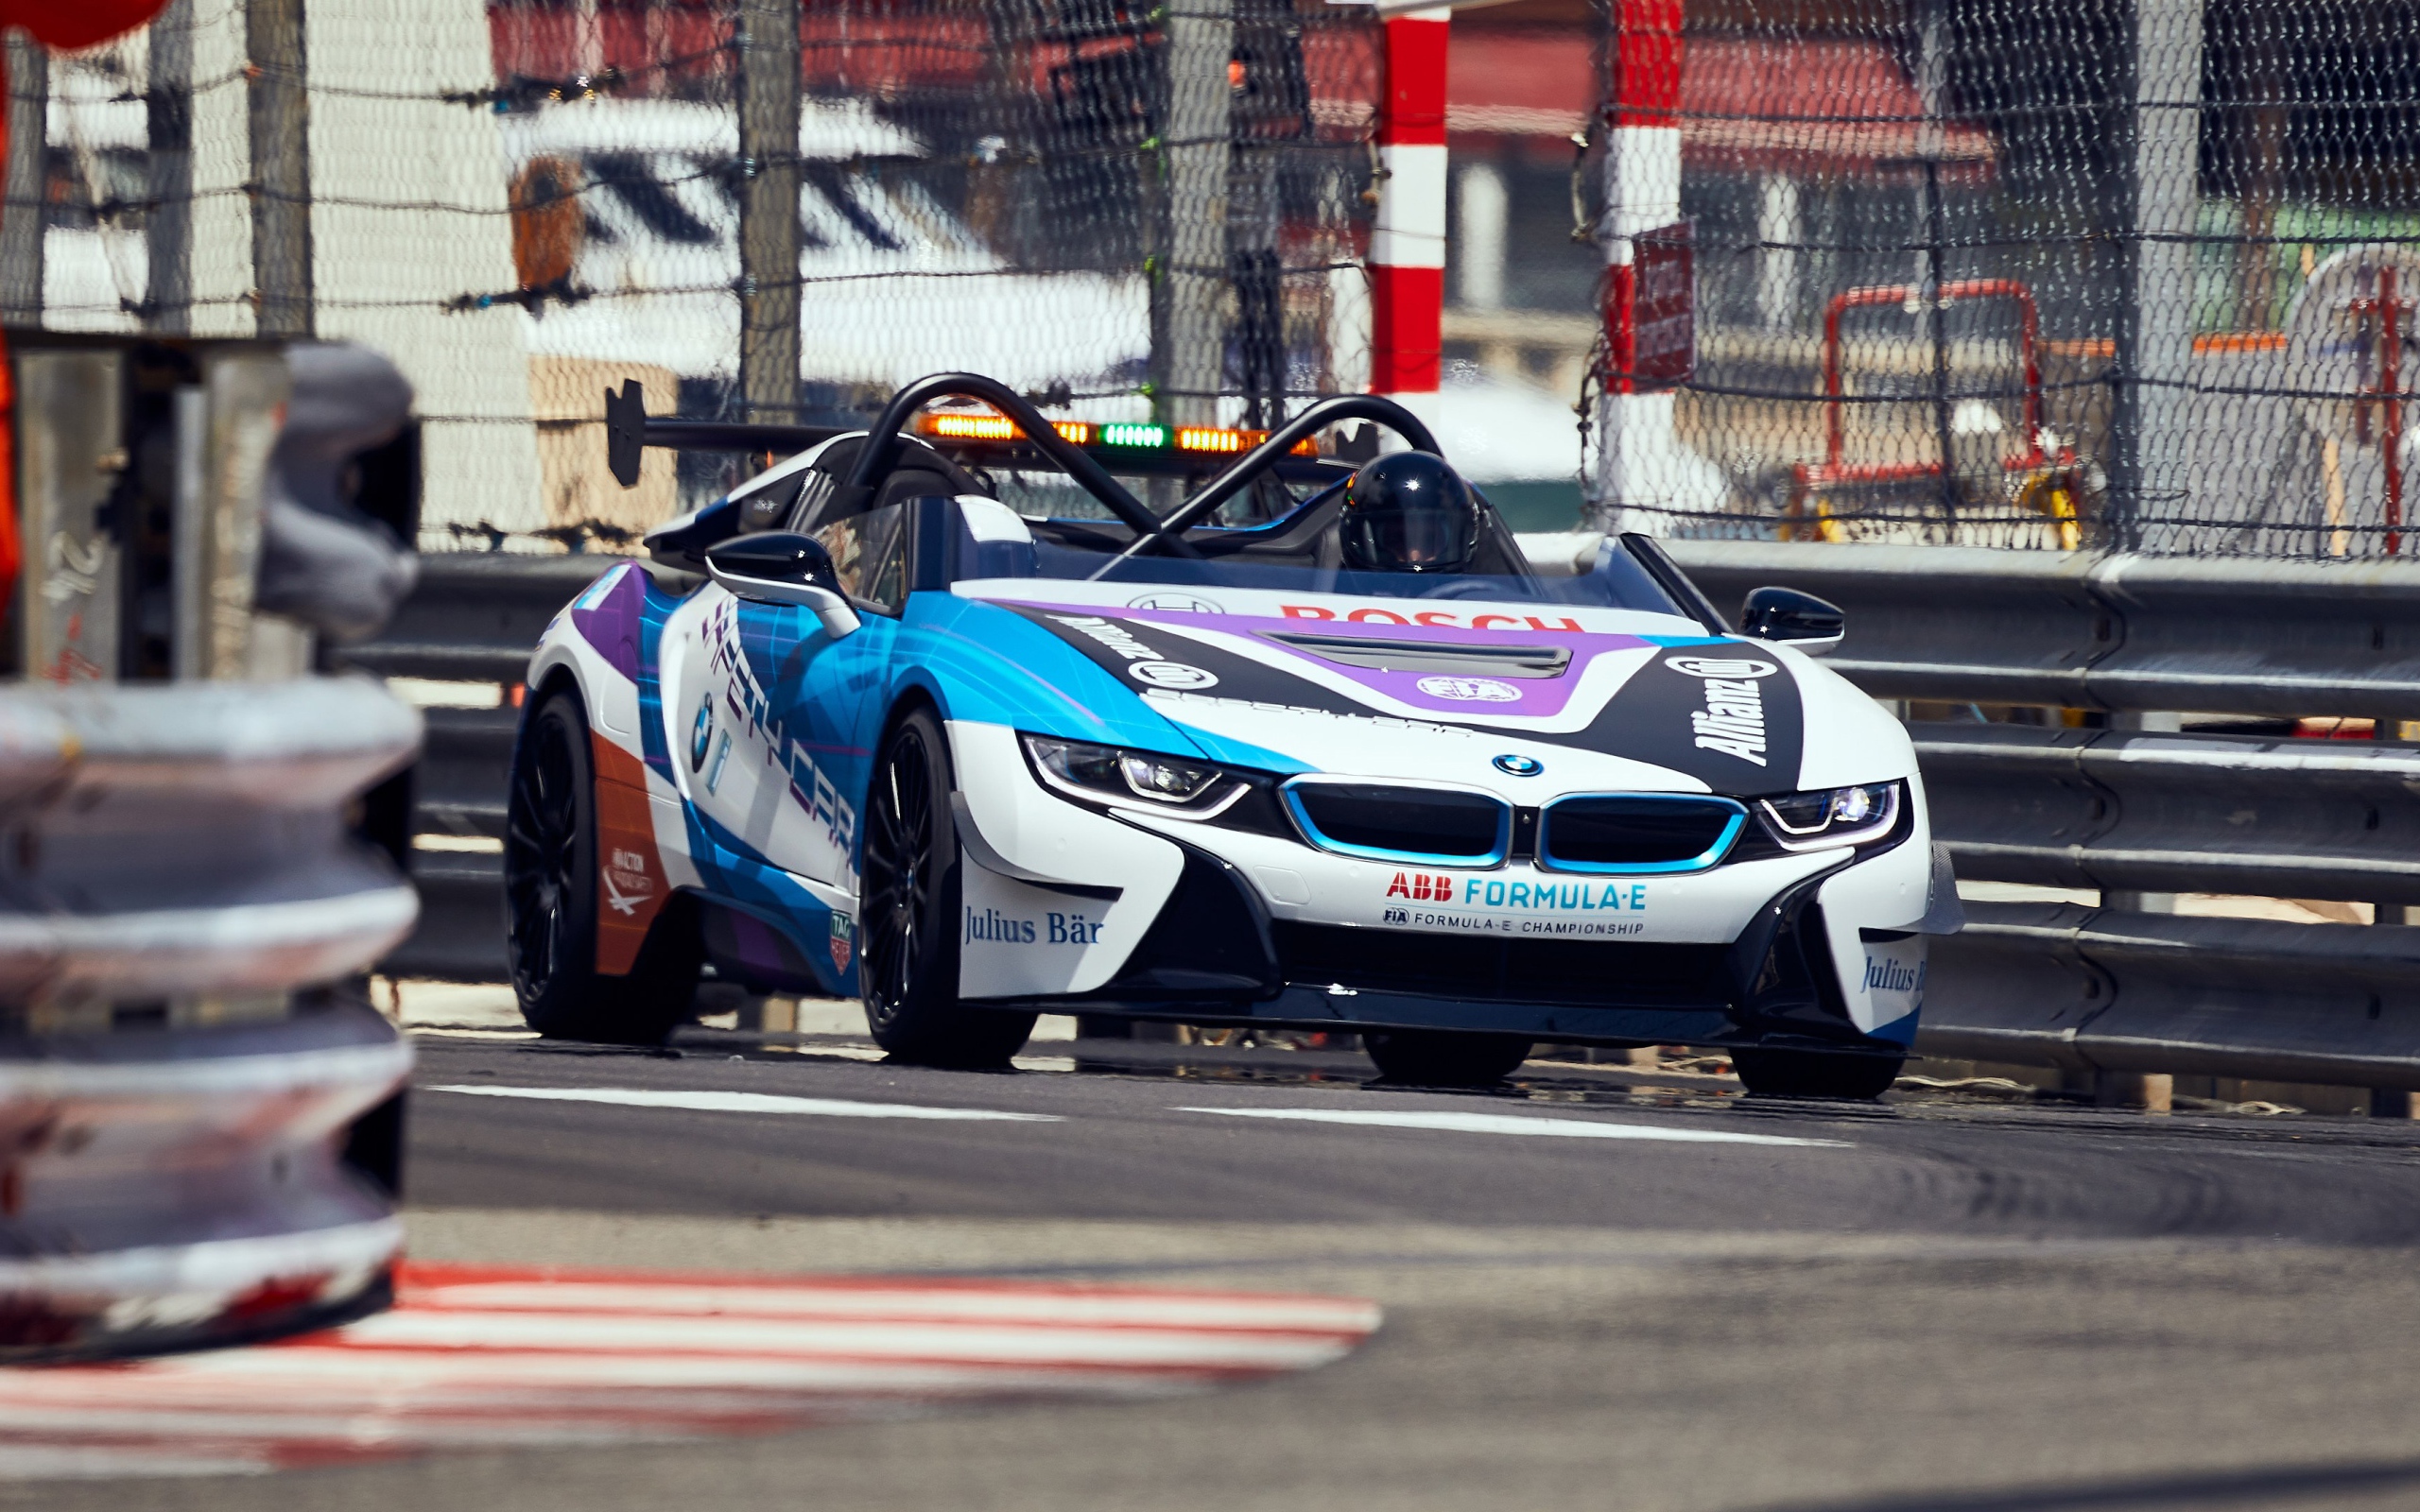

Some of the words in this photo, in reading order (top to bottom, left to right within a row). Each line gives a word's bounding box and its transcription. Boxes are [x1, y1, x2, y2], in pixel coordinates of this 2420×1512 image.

[1690, 679, 1767, 767] Allianz
[789, 737, 856, 869] CAR
[1386, 871, 1453, 902] ABB
[965, 905, 1036, 945] Julius
[1046, 912, 1104, 944] Bär
[1522, 921, 1644, 936] CHAMPIONSHIP
[1860, 956, 1915, 993] Julius
